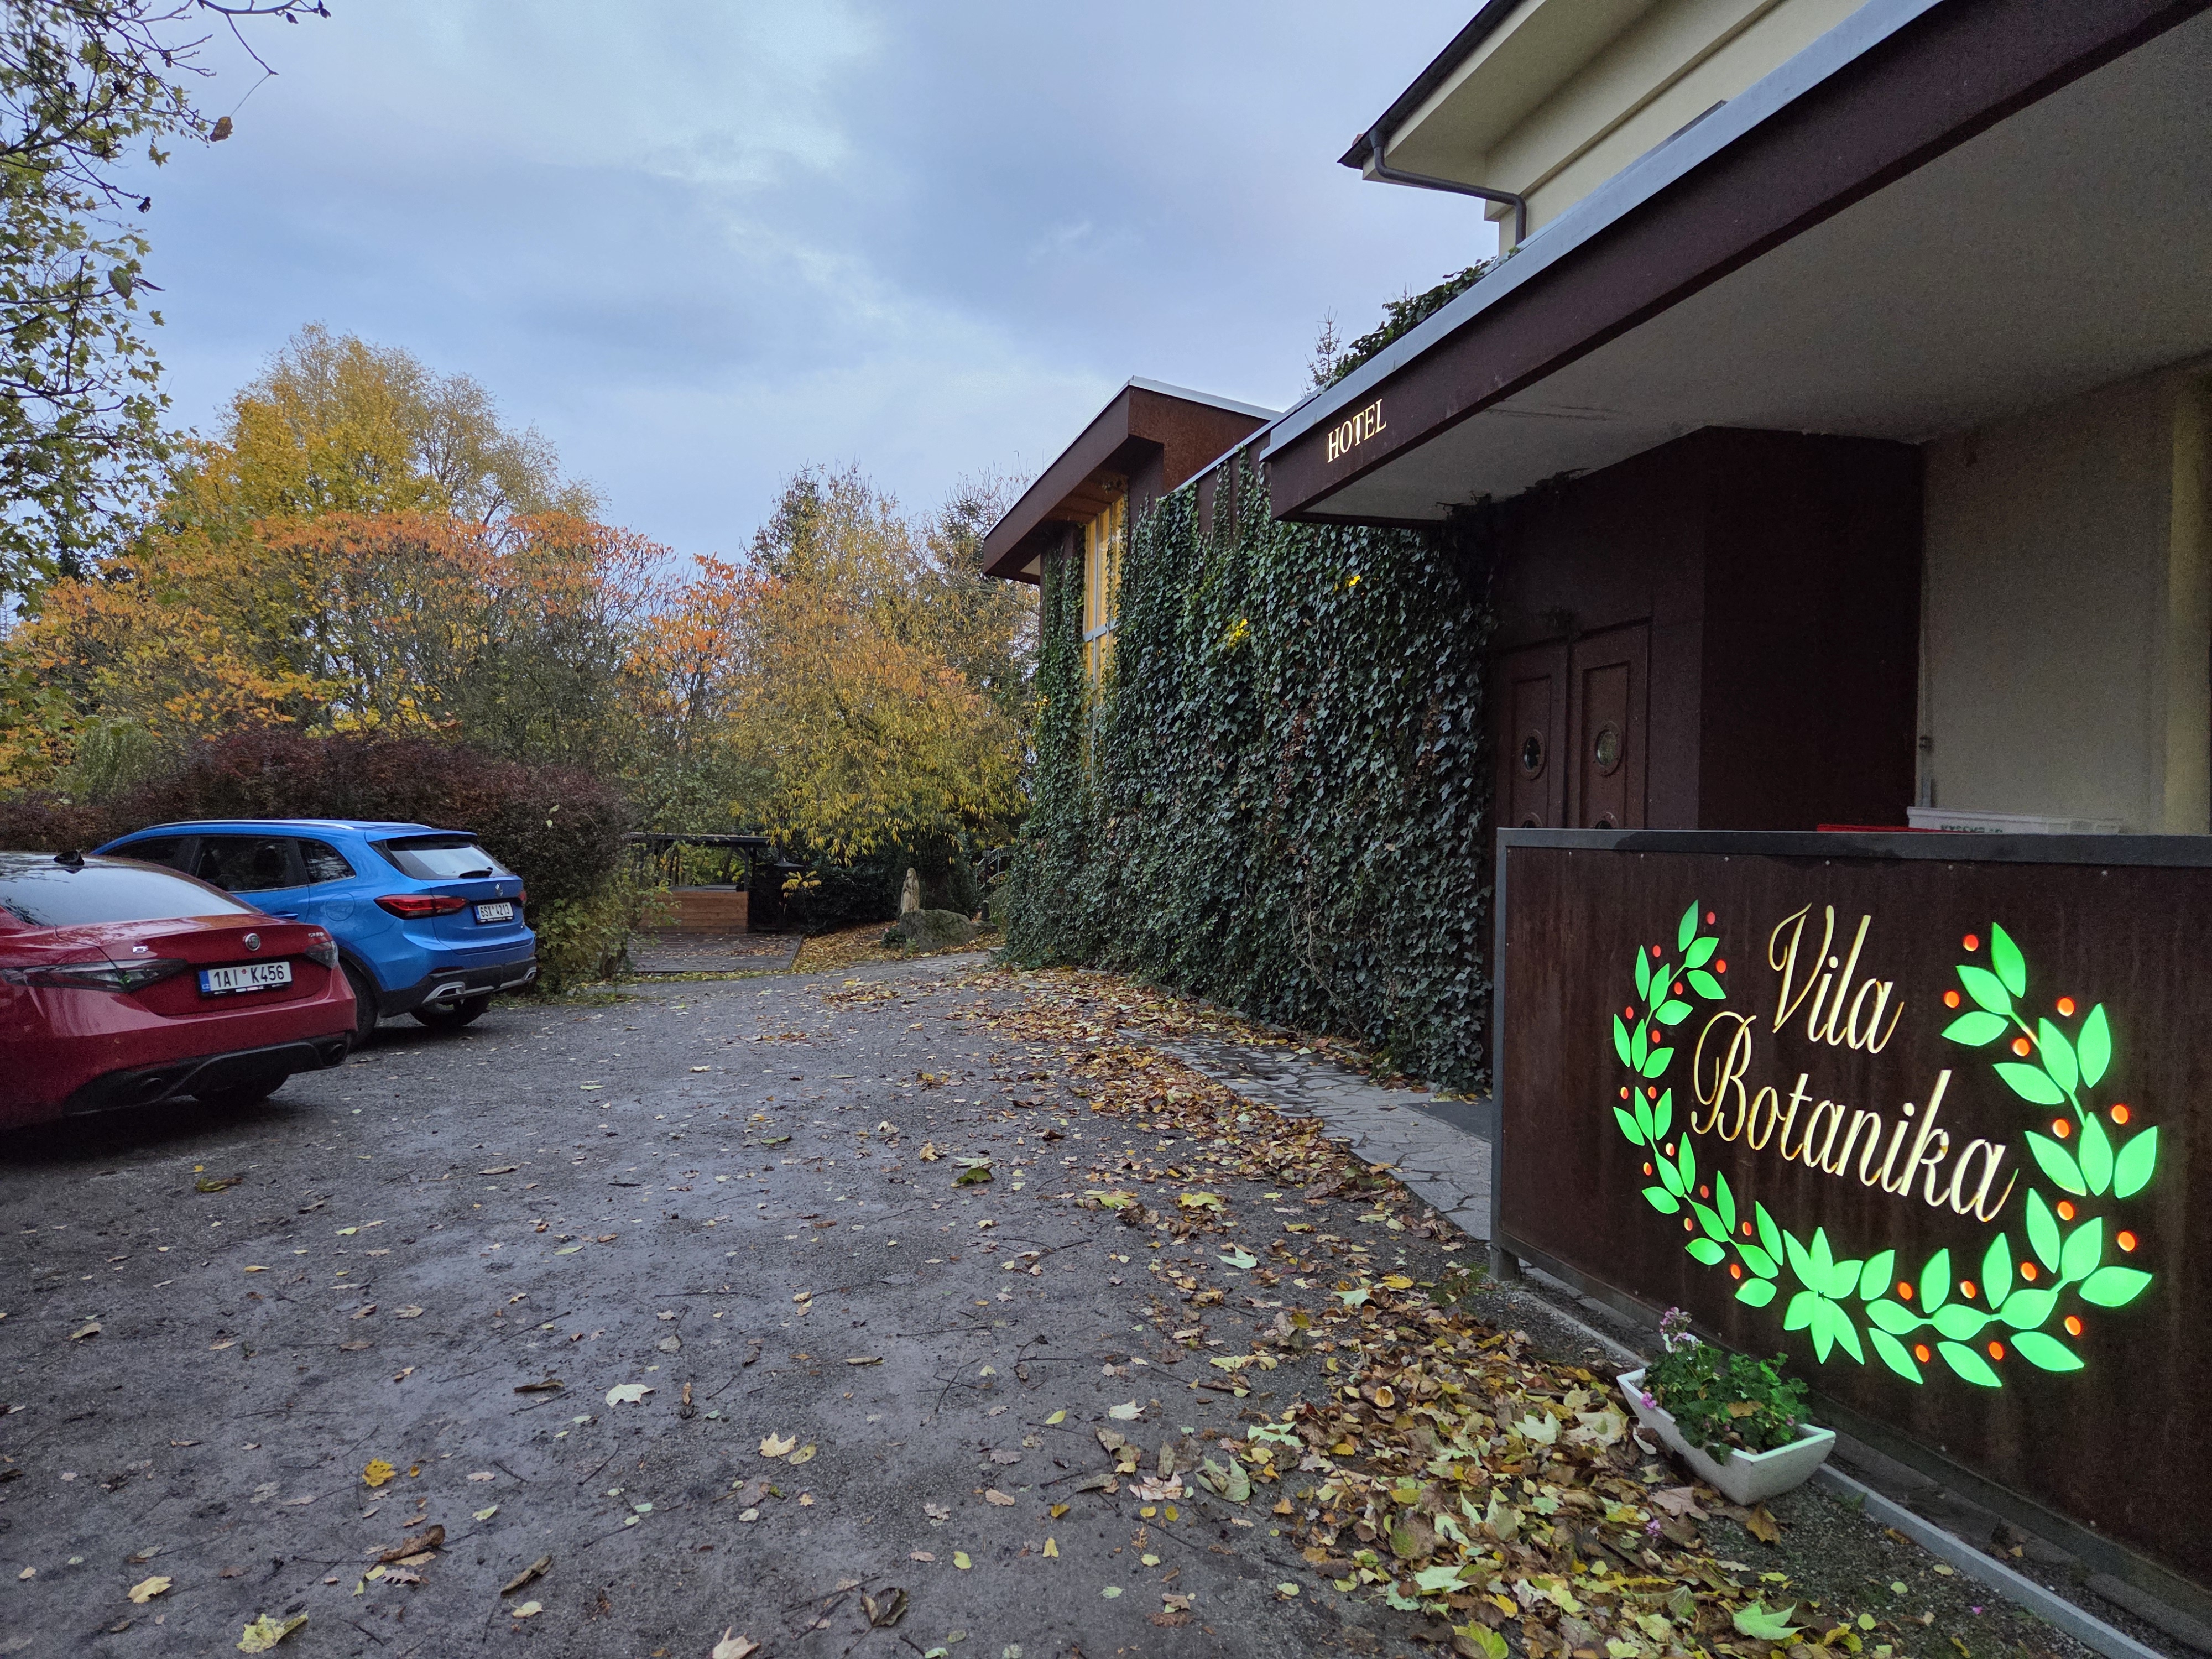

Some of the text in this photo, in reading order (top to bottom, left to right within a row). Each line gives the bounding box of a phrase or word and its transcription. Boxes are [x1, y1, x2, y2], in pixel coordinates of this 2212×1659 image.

[1327, 398, 1387, 463] HOTEL
[250, 964, 284, 984] K456
[1769, 902, 1904, 1054] Vila
[1691, 1011, 2019, 1222] Botanika
